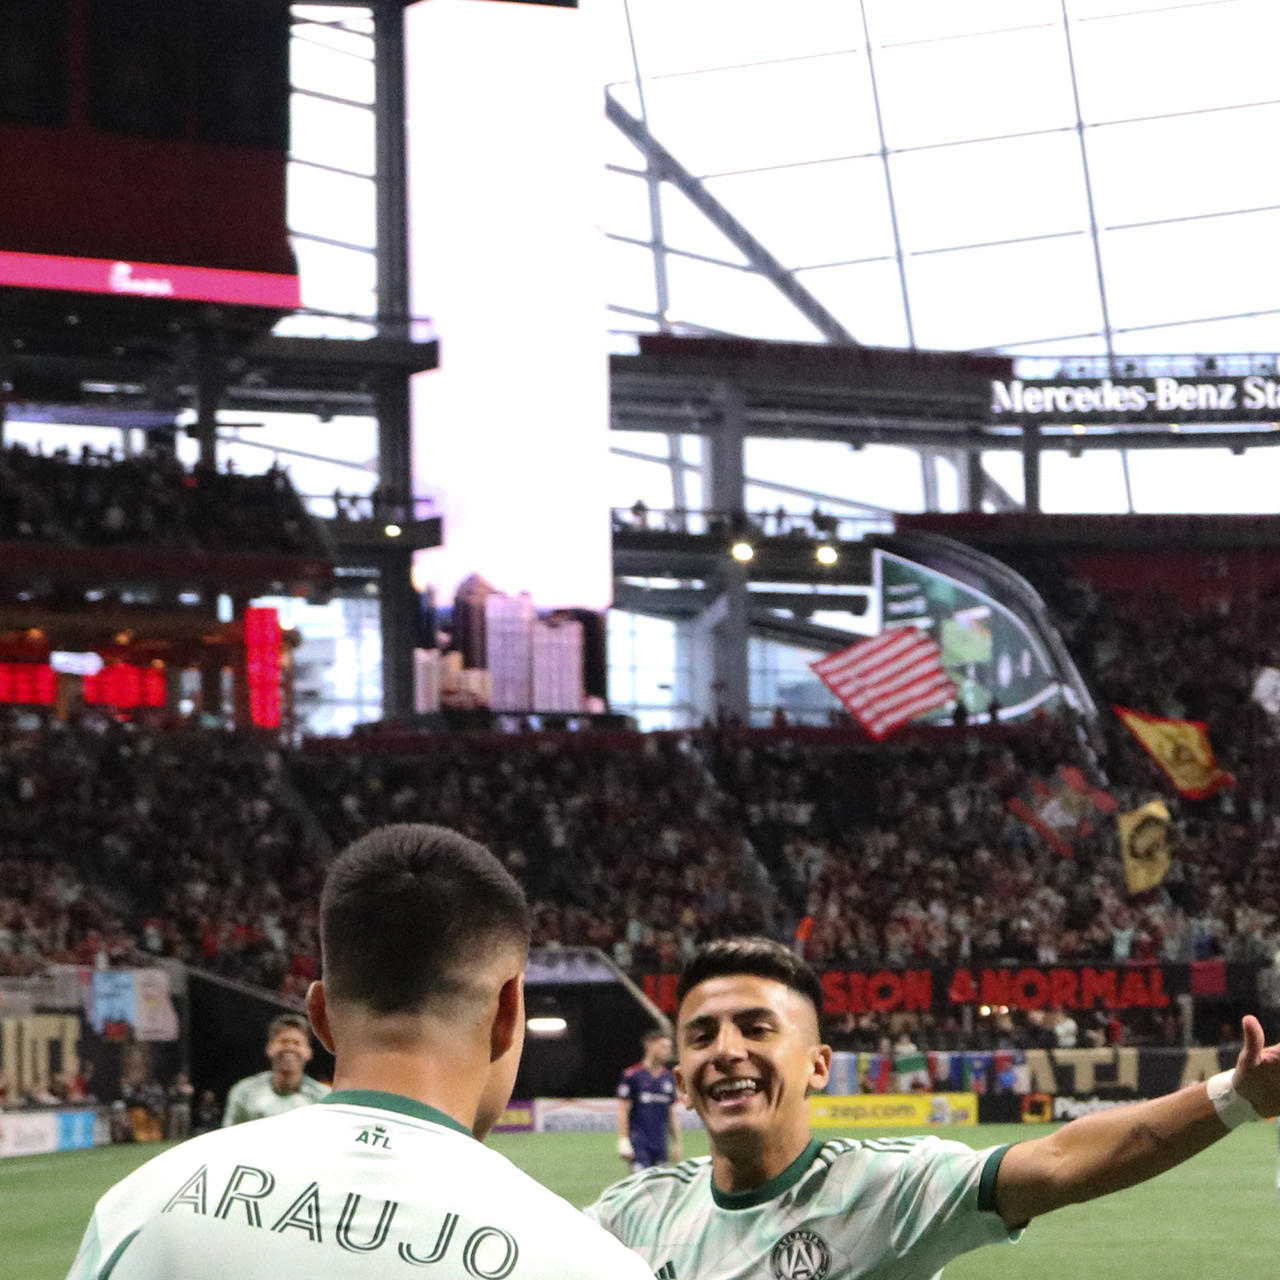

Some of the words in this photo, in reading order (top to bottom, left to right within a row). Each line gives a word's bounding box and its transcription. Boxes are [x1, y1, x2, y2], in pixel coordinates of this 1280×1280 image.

[992, 379, 1236, 413] Mercedes-Benz
[821, 970, 930, 1013] SION
[354, 1130, 393, 1150] ATL
[161, 1164, 519, 1280] ARAUJO
